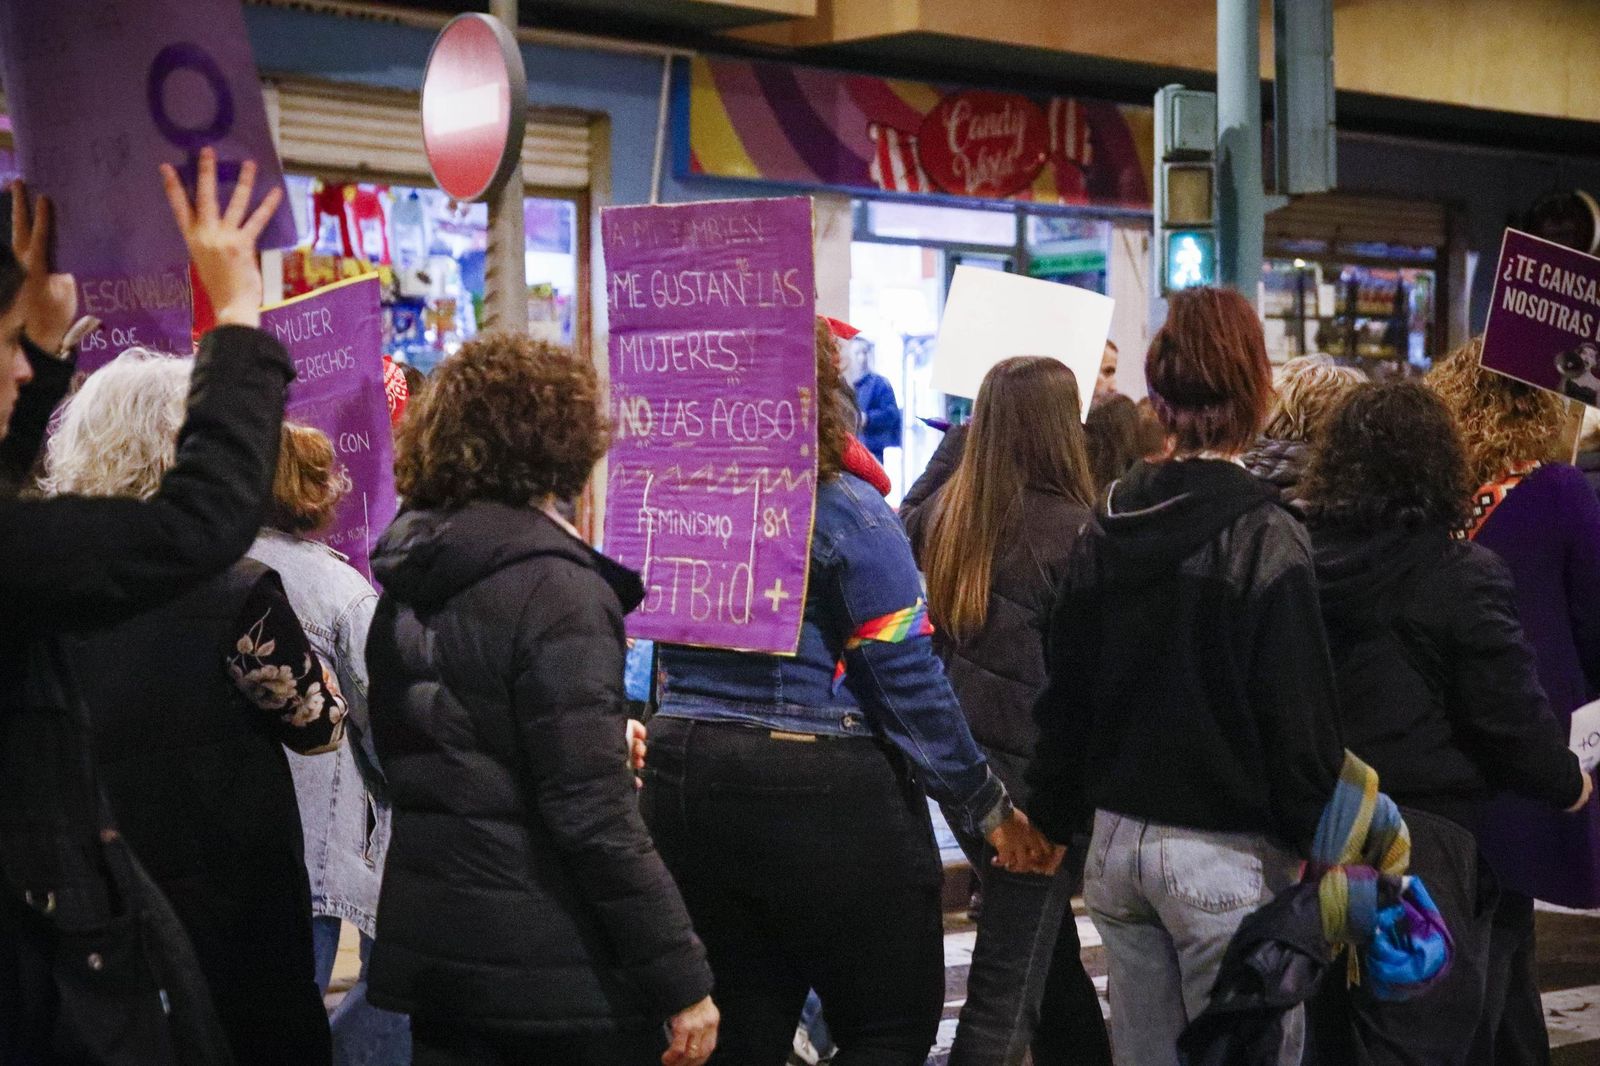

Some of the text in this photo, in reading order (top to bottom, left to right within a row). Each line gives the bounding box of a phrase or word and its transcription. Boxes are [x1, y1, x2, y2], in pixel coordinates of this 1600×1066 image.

[1503, 253, 1537, 283] ¿TE
[612, 268, 805, 309] ME GUSTAN LAS
[1502, 285, 1593, 339] NOSOTRAS
[80, 328, 107, 352] LAS
[111, 326, 140, 347] QUE
[619, 330, 739, 374] MUJERES
[294, 345, 356, 383] ERECHOS
[617, 395, 653, 440] NO
[661, 398, 704, 437] LAS
[339, 431, 371, 453] CON
[762, 506, 792, 539] 8M
